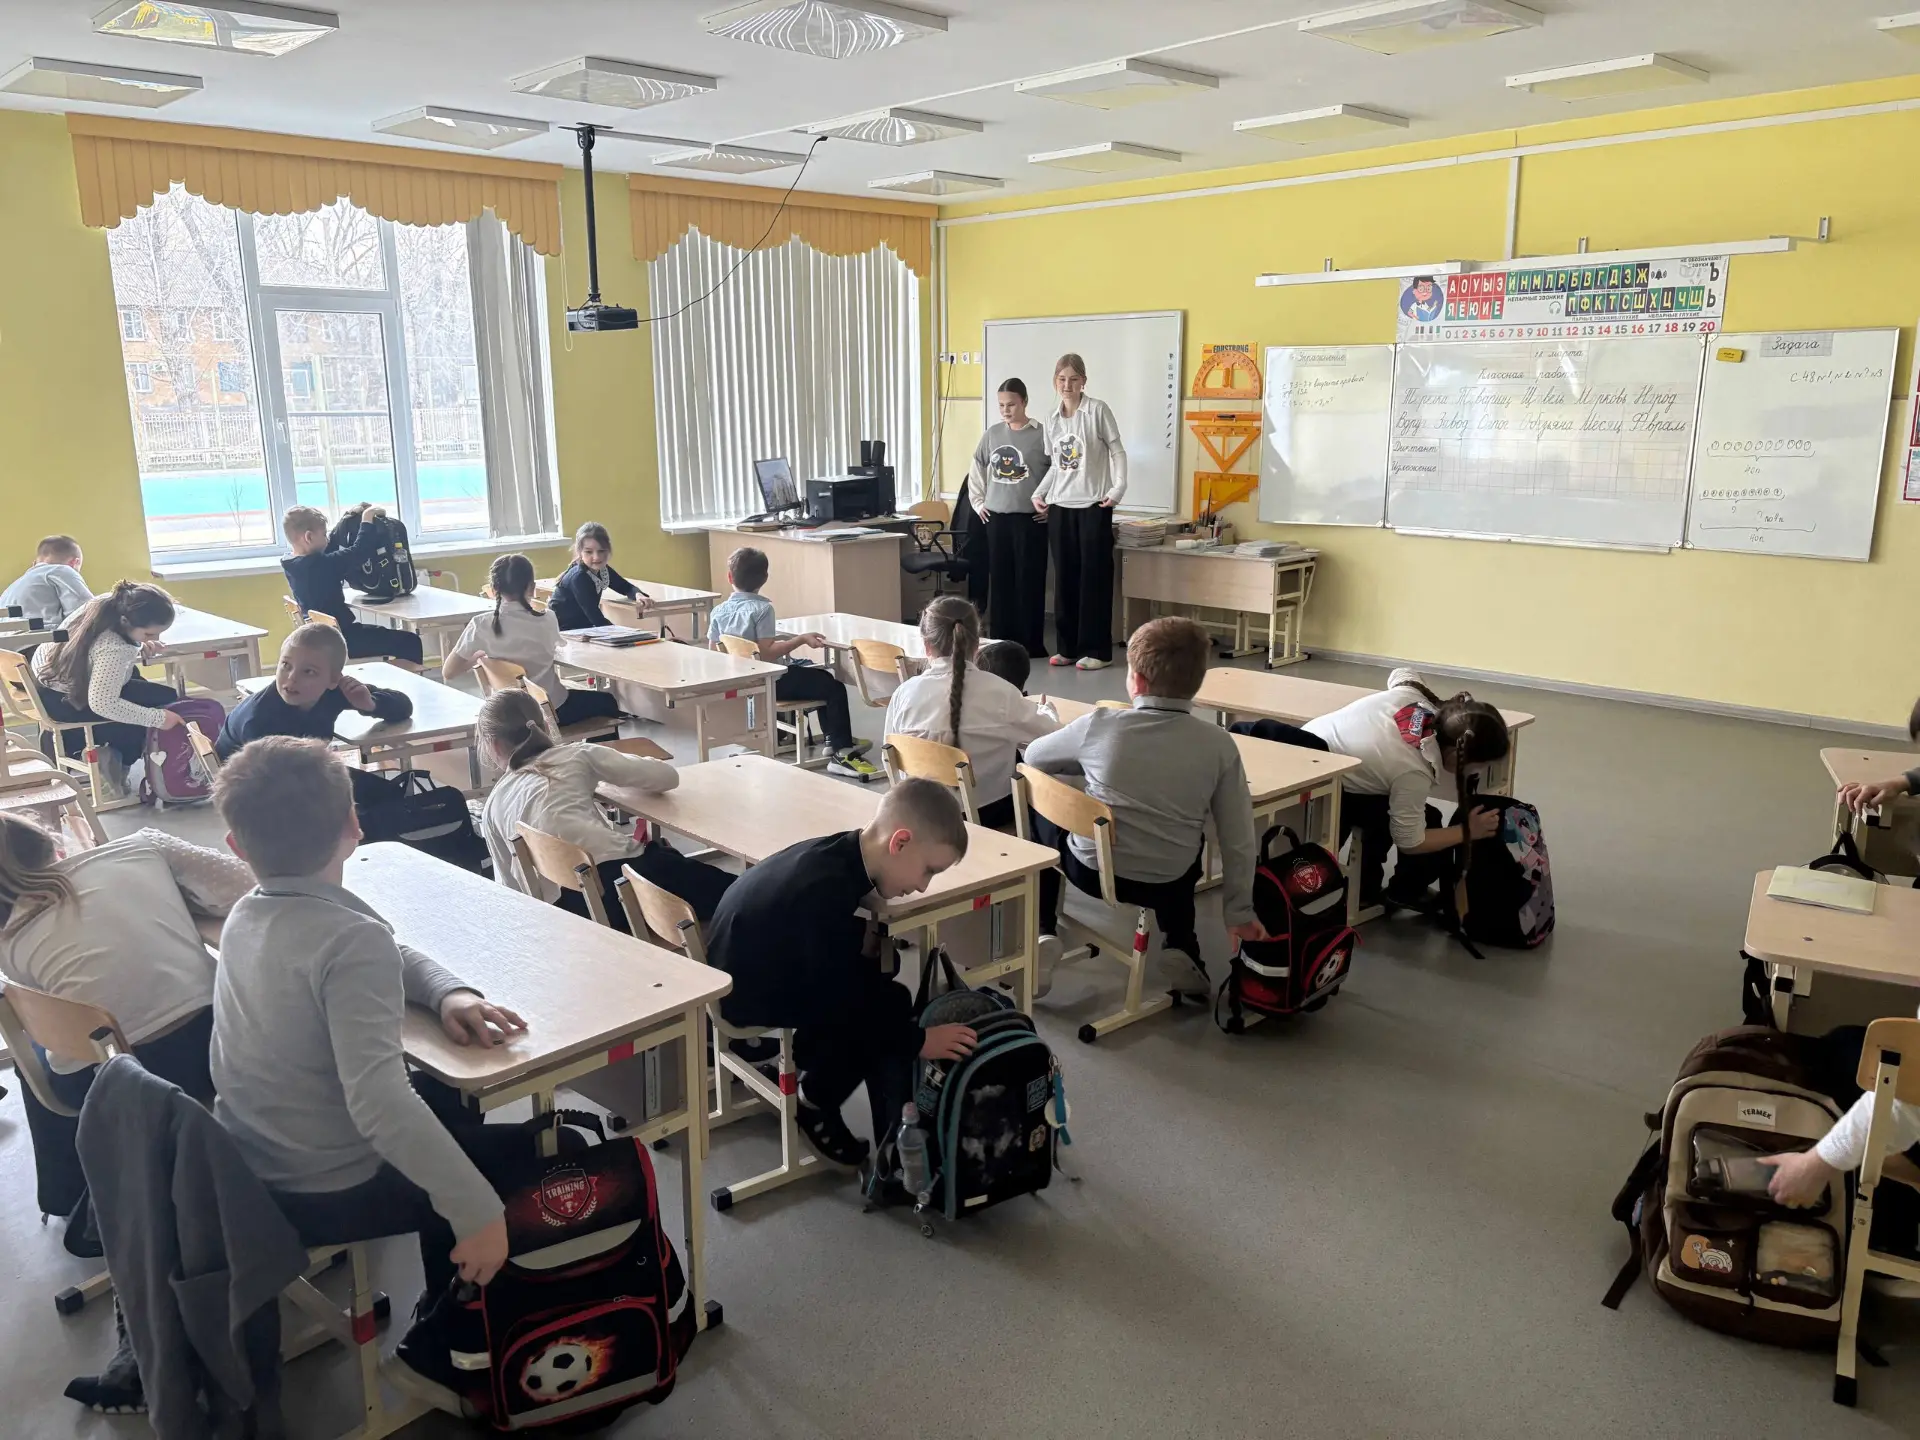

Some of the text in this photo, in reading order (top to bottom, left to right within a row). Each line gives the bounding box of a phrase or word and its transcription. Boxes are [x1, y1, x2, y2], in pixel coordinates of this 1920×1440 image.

[1449, 268, 1648, 293] А О У Ы Э Й Н М Л Р Б В Г Д З Ж
[1709, 262, 1720, 281] Ъ
[1568, 289, 1703, 312] П Ф К Т С Ш Х Ц Ч Щ
[1706, 288, 1717, 308] Ь
[1448, 300, 1501, 318] Я Ё Ю И Е
[1445, 322, 1715, 339] 0 1 2 3 4 5 6 7 8 9 10 11 12 13 14 15 16 17 18 19 20
[1772, 336, 1820, 354] Задача
[1478, 368, 1524, 379] Классная
[1401, 387, 1448, 412] Трелка
[1455, 386, 1512, 412] Тварищ
[1520, 385, 1565, 408] Щвель
[545, 1180, 585, 1200] TRAINING
